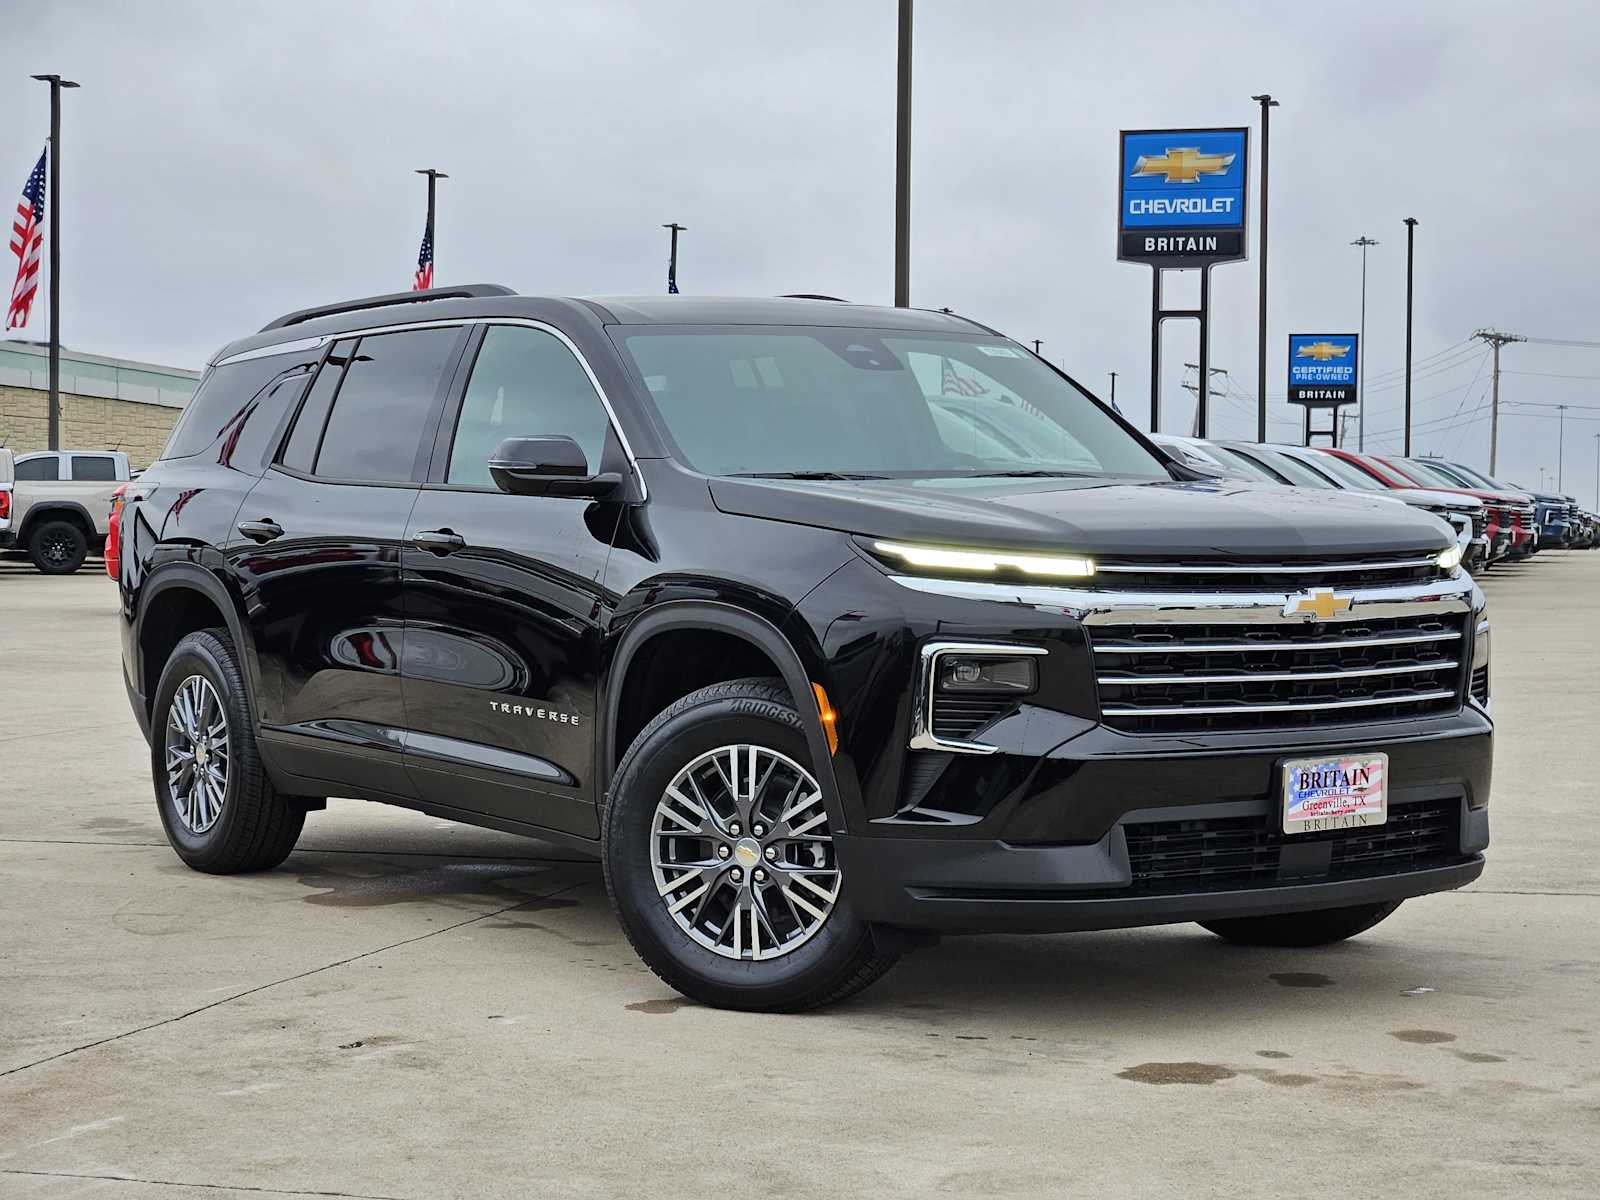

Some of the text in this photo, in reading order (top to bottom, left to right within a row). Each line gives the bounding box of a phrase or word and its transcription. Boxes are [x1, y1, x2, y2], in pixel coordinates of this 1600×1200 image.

[1129, 197, 1235, 215] CHEVROLET
[1144, 236, 1217, 252] BRITAIN
[1292, 366, 1353, 374] CERTIFIED
[1295, 373, 1349, 381] PRE-OWNED
[1298, 390, 1345, 399] BRITAIN
[489, 701, 579, 726] TRAVERSE
[1300, 767, 1370, 790] BRITAIN
[1298, 788, 1350, 799] CHEVROLET
[1302, 796, 1366, 811] Greenville, TX
[1304, 814, 1368, 831] BRITAIN
